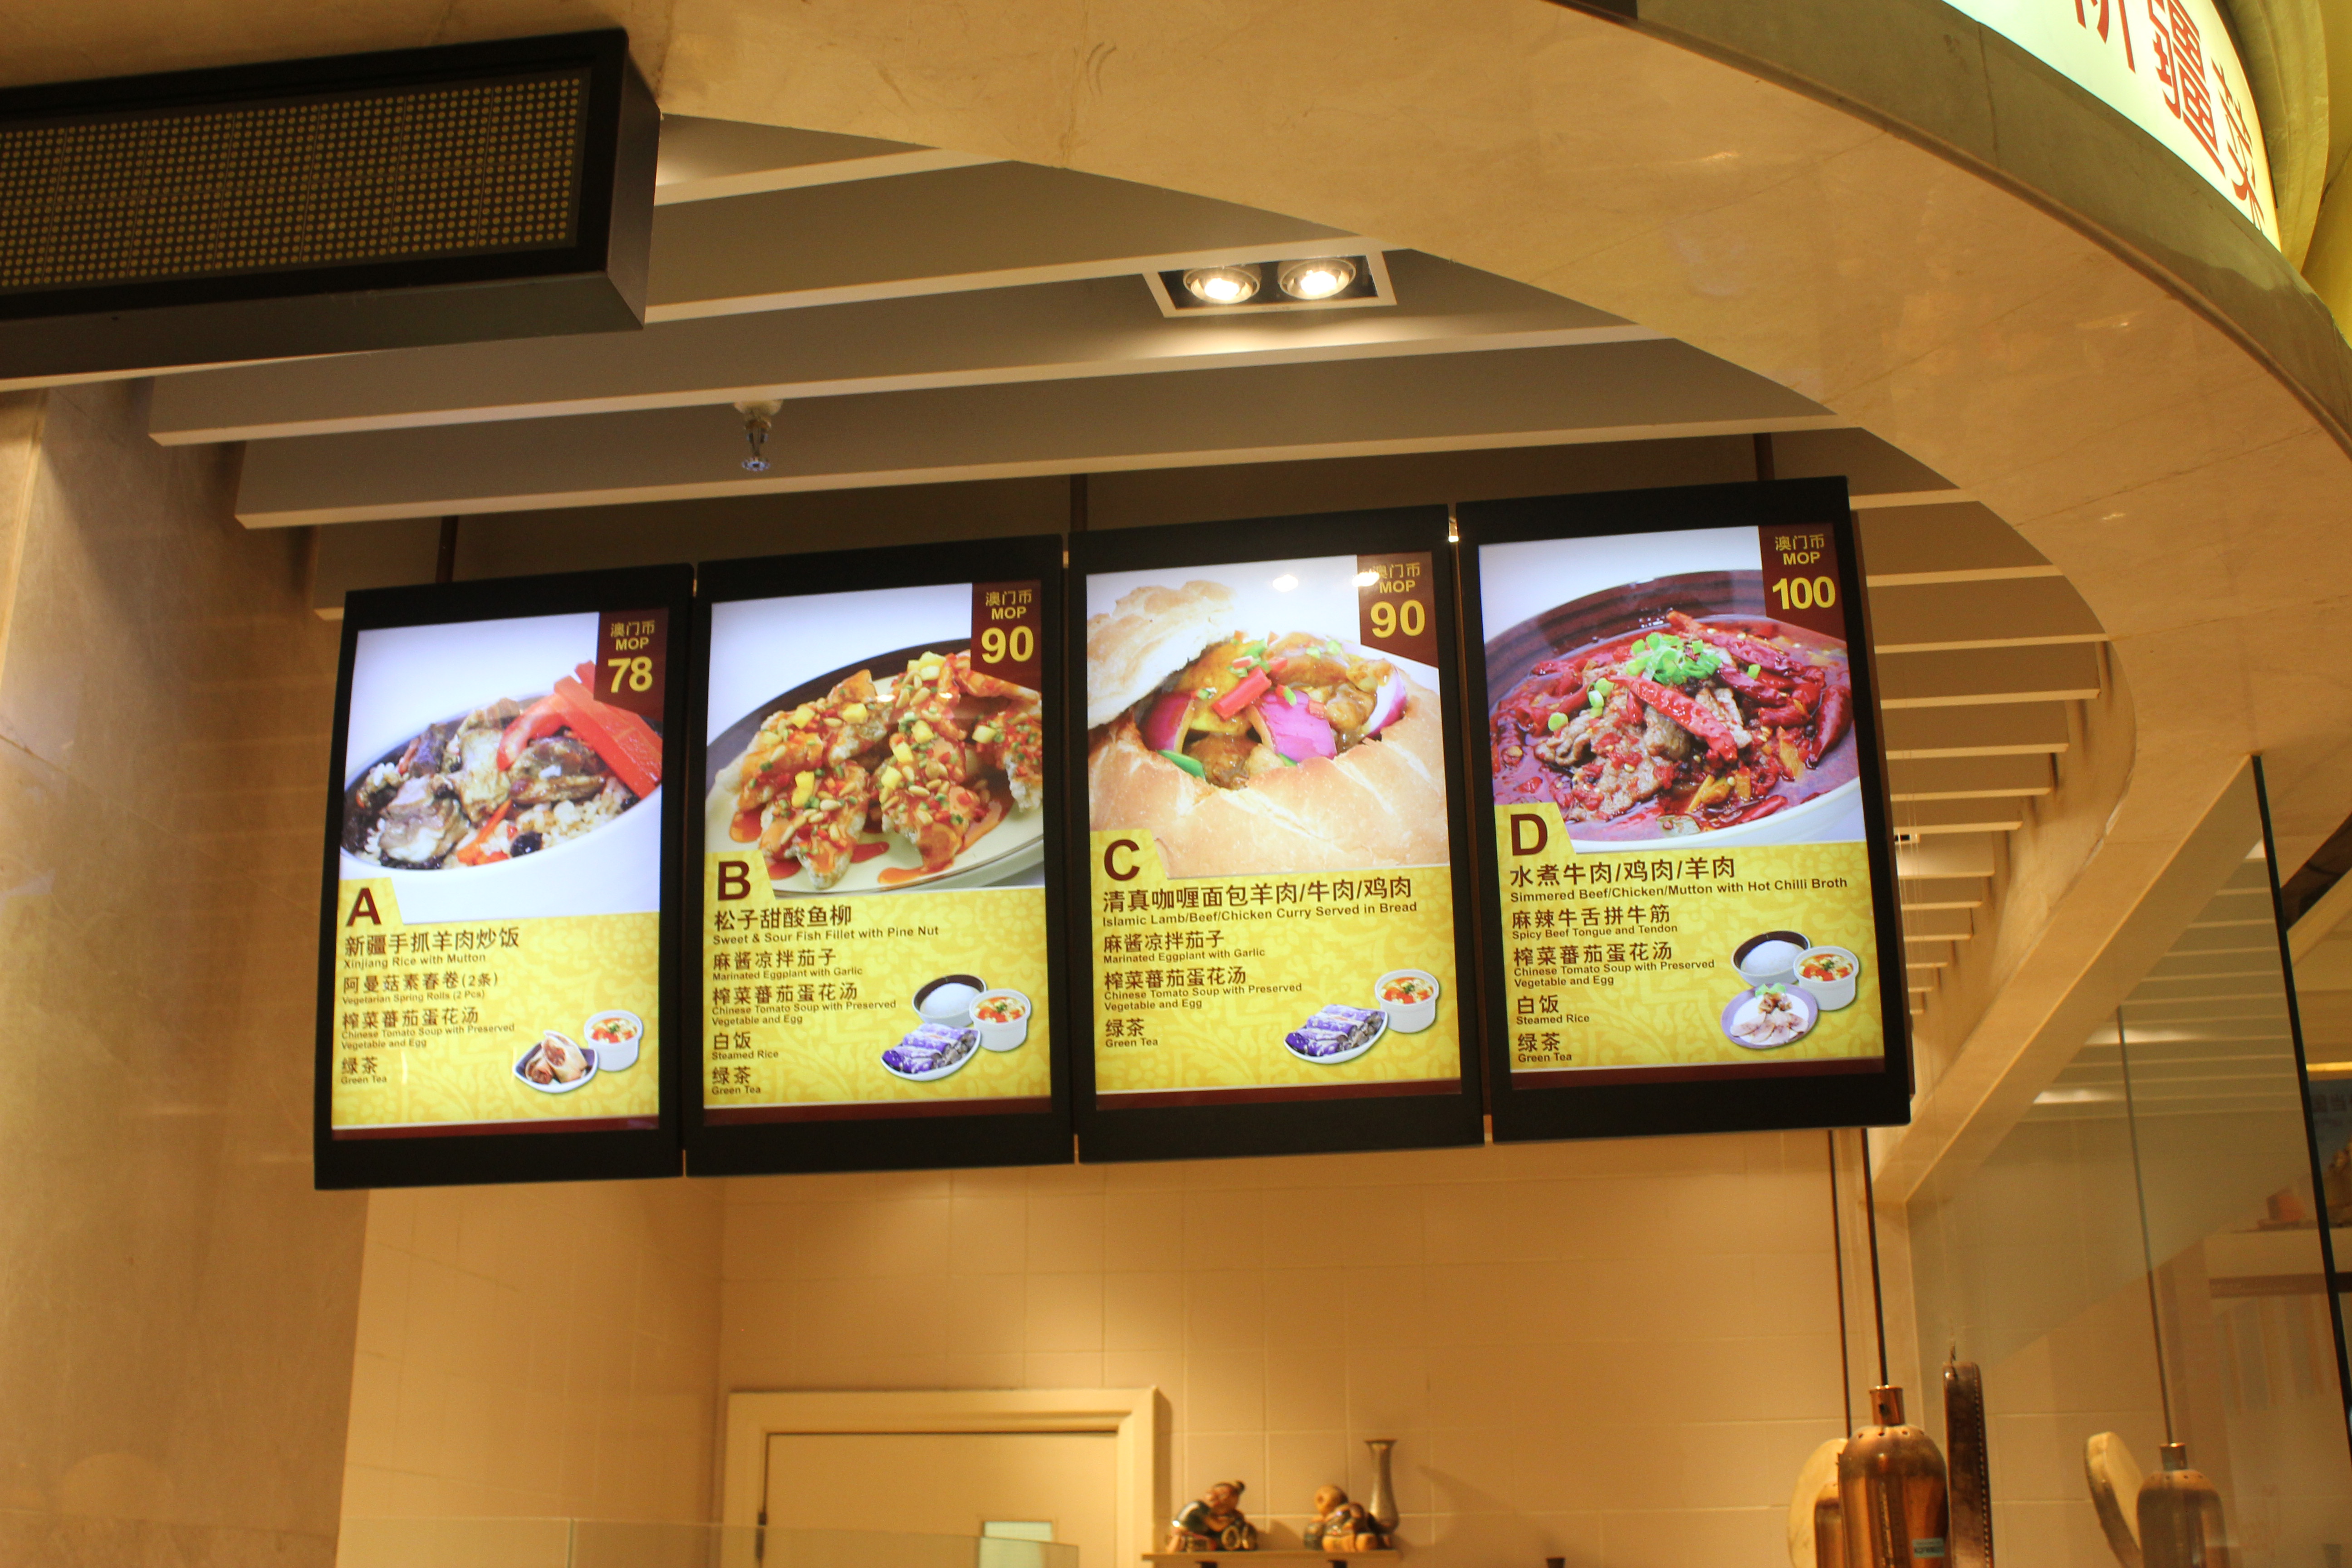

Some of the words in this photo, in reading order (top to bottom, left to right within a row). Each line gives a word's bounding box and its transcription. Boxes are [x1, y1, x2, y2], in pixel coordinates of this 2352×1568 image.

[2075, 0, 2266, 232] 疆菜
[1775, 534, 1825, 551] 澳门币
[1783, 551, 1820, 565] MOP
[1379, 579, 1416, 594] MOP
[1772, 576, 1836, 610] 100
[985, 589, 1032, 607] 澳门币
[991, 606, 1027, 620] MOP
[1370, 599, 1426, 638] 90
[611, 619, 655, 637] 澳门币
[616, 637, 649, 651] MOP
[981, 625, 1034, 664] 90
[608, 656, 653, 693] 78
[1510, 813, 1548, 857] D
[1104, 839, 1140, 881] C
[717, 860, 751, 901] B
[1510, 855, 1735, 888] 水煮牛肉/鸡肉/羊肉
[1103, 876, 1411, 914] 清真咖喱面包羊肉/牛肉/鸡肉
[1510, 889, 1575, 904] Simmered
[1579, 883, 1713, 900] Beef/Chicken/Mutton
[1717, 881, 1744, 893] with
[1748, 880, 1771, 892] Hot
[1775, 877, 1808, 891] Chilli
[1812, 876, 1847, 889] Broth
[346, 887, 382, 927] A
[1102, 916, 1147, 927] Islamic
[1151, 909, 1272, 925] Lamb/Beef/Chicken
[1277, 907, 1311, 920] Curry
[1316, 904, 1359, 917] Served
[1364, 903, 1375, 914] in
[1380, 902, 1417, 913] Bread
[714, 904, 852, 931] 松子甜酸鱼柳
[1512, 904, 1670, 930] 麻辣牛舌拼牛筋
[345, 926, 519, 956] 新疆手抓羊肉炒饭
[713, 934, 748, 945] Sweet
[752, 932, 760, 942] &
[764, 931, 792, 942] Sour
[796, 931, 821, 941] Fish
[825, 929, 855, 940] Fillet
[858, 928, 883, 938] with
[887, 927, 913, 937] Pine
[918, 926, 939, 936] Nut
[1103, 930, 1224, 953] 麻酱凉拌茄子
[1512, 930, 1541, 941] Spicy
[1545, 929, 1569, 938] Beef
[1573, 927, 1612, 939] Tongue
[1615, 926, 1634, 935] and
[1638, 924, 1678, 934] Tendon
[344, 959, 388, 969] Xinjiang
[392, 957, 416, 966] Rice
[420, 955, 443, 965] with
[447, 953, 485, 963] Mutton
[713, 948, 836, 970] 麻酱凉拌茄子
[1104, 953, 1155, 965] Marinated
[1158, 951, 1205, 963] Eggplant
[1208, 950, 1230, 959] with
[1234, 948, 1265, 957] Garlic
[713, 971, 760, 980] Marinated
[763, 969, 807, 980] Eggplant
[810, 969, 831, 977] with
[834, 966, 862, 976] Garlic
[1514, 966, 1557, 977] Chinese
[1561, 965, 1600, 975] Tomato
[1603, 963, 1631, 975] Soup
[1635, 961, 1656, 972] with
[1660, 959, 1715, 970] Preserved
[1514, 977, 1567, 989] Vegetable
[1570, 976, 1589, 985] and
[1593, 975, 1614, 987] Egg
[343, 996, 390, 1005] Vegetarian
[394, 993, 423, 1003] Spring
[427, 992, 450, 1000] Rolls
[453, 992, 461, 1000] (2
[465, 990, 485, 999] Pcs)
[1105, 990, 1147, 1000] Chinese
[1150, 989, 1189, 999] Tomato
[1192, 987, 1220, 998] Soup
[1223, 985, 1245, 995] with
[1249, 983, 1302, 994] Preserved
[712, 1005, 751, 1015] Chinese
[755, 1004, 791, 1014] Tomato
[794, 1003, 819, 1014] Soup
[822, 1002, 843, 1011] with
[846, 1000, 897, 1010] Preserved
[1105, 1000, 1156, 1013] Vegetable
[1159, 1000, 1178, 1009] and
[1182, 999, 1202, 1010] Egg
[1517, 995, 1559, 1015] 白饭
[712, 1015, 759, 1027] Vegetable
[763, 1015, 780, 1024] and
[784, 1014, 803, 1025] Egg
[1105, 1018, 1145, 1038] 绿茶
[1516, 1014, 1563, 1025] Steamed
[1567, 1013, 1589, 1023] Rice
[342, 1030, 378, 1039] Chinese
[382, 1029, 415, 1037] Tomato
[418, 1028, 442, 1037] Soup
[467, 1023, 514, 1033] Preserved
[342, 1040, 385, 1050] Vegetable
[408, 1038, 426, 1048] Egg
[714, 1031, 751, 1051] 白饭
[1106, 1038, 1137, 1048] Green
[1141, 1037, 1158, 1047] Tea
[1518, 1032, 1561, 1053] 绿茶
[712, 1050, 754, 1060] Steamed
[757, 1049, 779, 1058] Rice
[1519, 1052, 1550, 1063] Green
[1554, 1052, 1572, 1061] Tea
[342, 1056, 378, 1075] 绿茶
[341, 1076, 368, 1085] Green
[372, 1075, 387, 1083] Tea
[712, 1066, 751, 1086] 绿茶
[712, 1086, 740, 1095] Green
[745, 1085, 761, 1093] Tea
